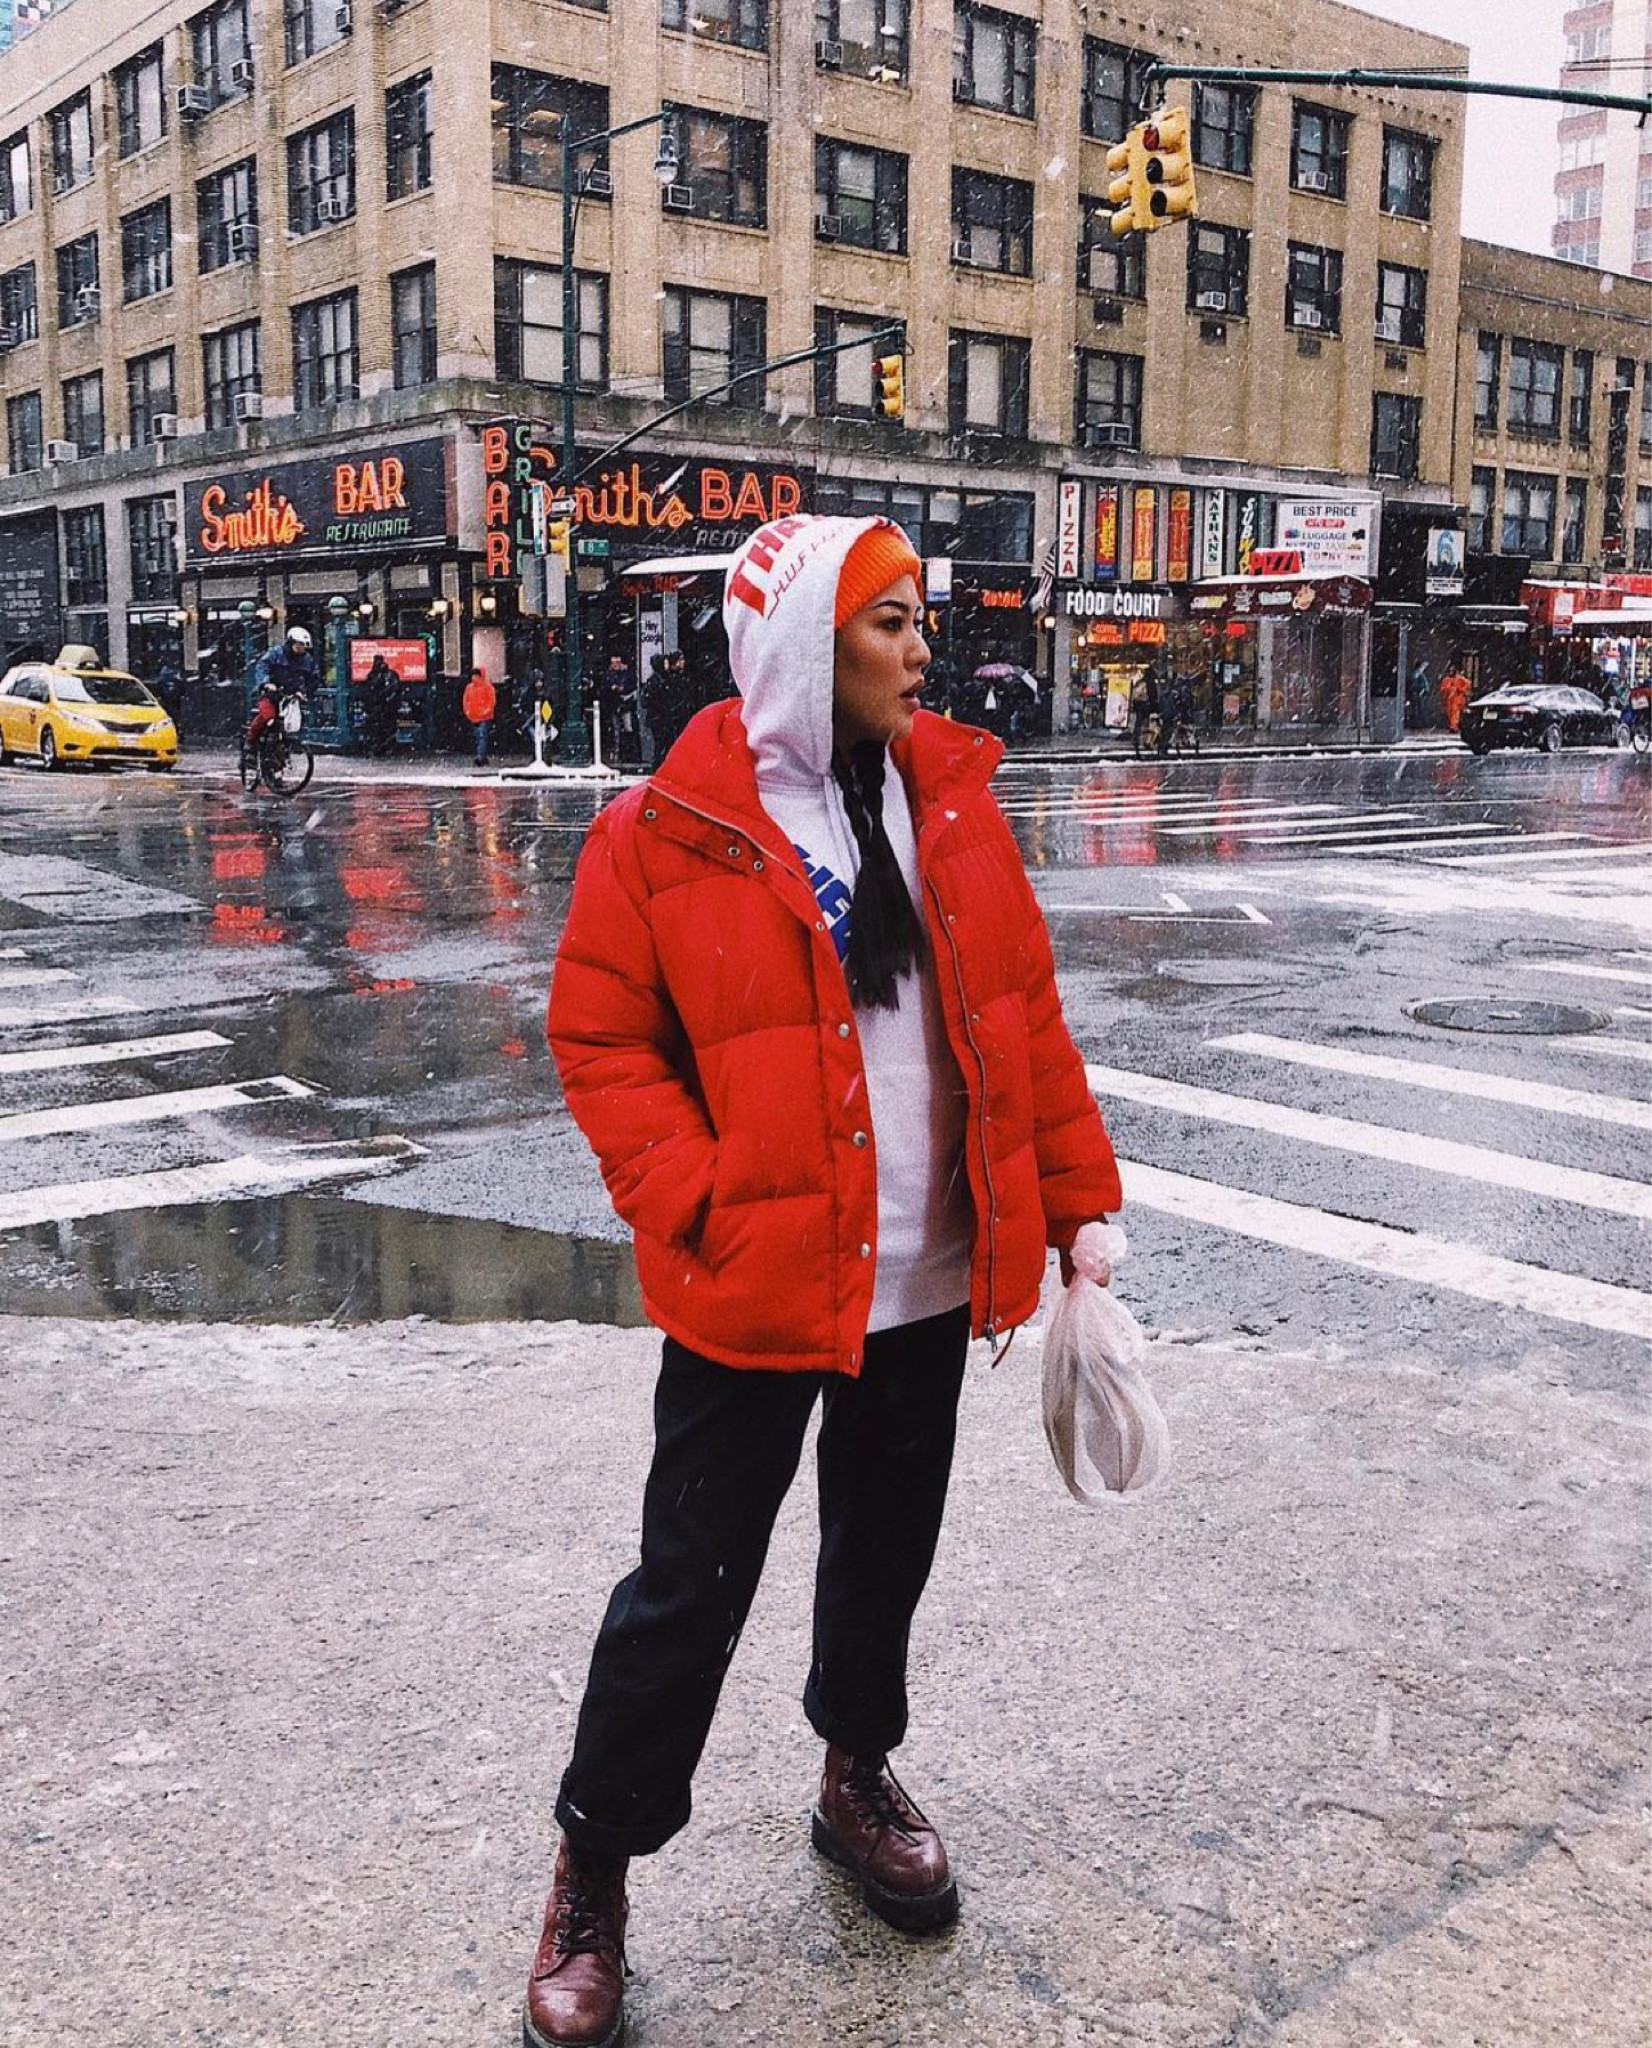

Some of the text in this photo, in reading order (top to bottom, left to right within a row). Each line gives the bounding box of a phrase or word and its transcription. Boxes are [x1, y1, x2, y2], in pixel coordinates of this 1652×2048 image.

[202, 457, 407, 552] Smith's BAR
[485, 426, 511, 576] BAR
[701, 467, 800, 523] BAR
[1293, 506, 1358, 517] BEST PRICE
[1063, 485, 1075, 574] PIZZA
[1208, 491, 1220, 562] NATHANS
[1302, 532, 1347, 541] LUGGAGE
[1066, 590, 1105, 616] FOOD
[1113, 591, 1162, 617] COURT
[1131, 621, 1166, 643] PIZZA
